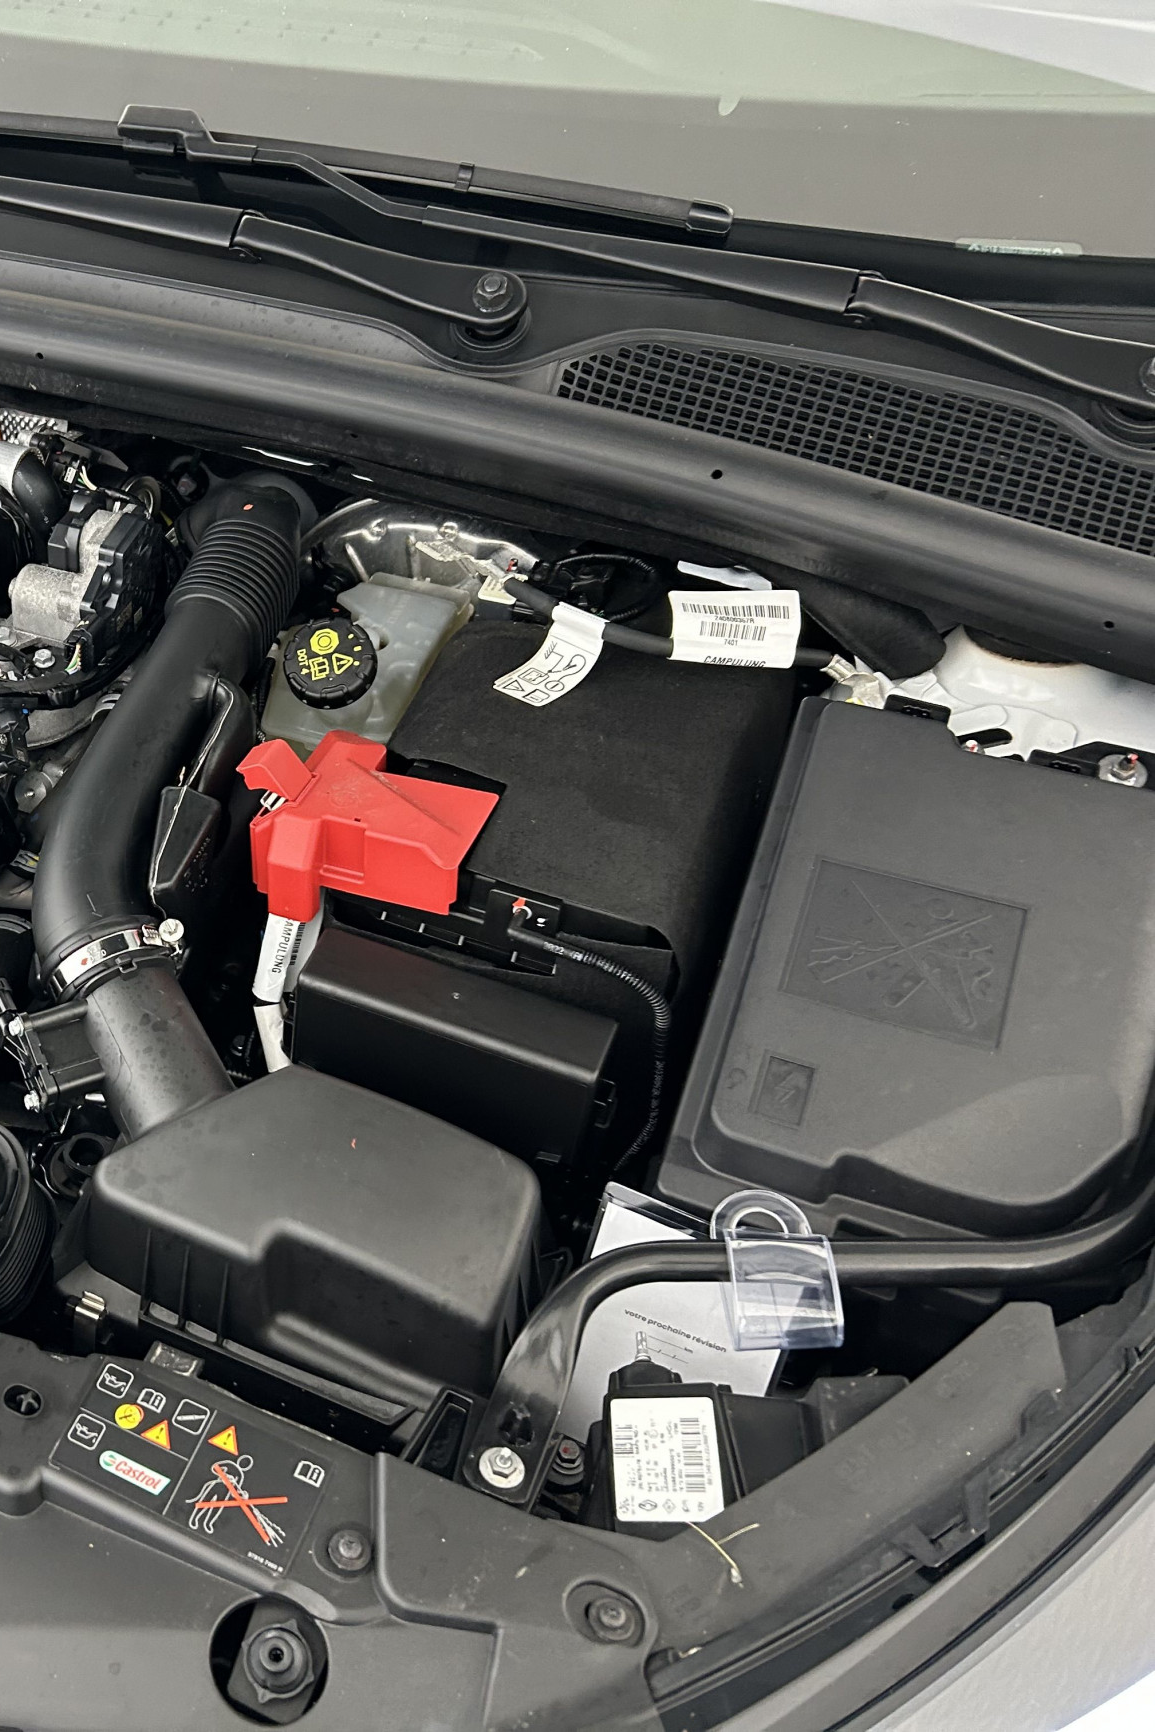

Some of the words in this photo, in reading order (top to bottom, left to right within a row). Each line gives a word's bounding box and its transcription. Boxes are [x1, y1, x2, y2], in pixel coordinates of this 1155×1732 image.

[297, 648, 308, 666] DOT
[300, 667, 310, 675] 4
[271, 920, 294, 974] AMPULUNG
[625, 1309, 647, 1322] votre
[647, 1319, 692, 1339] prochaine
[692, 1335, 726, 1353] révision
[114, 1460, 161, 1489] Castrol
